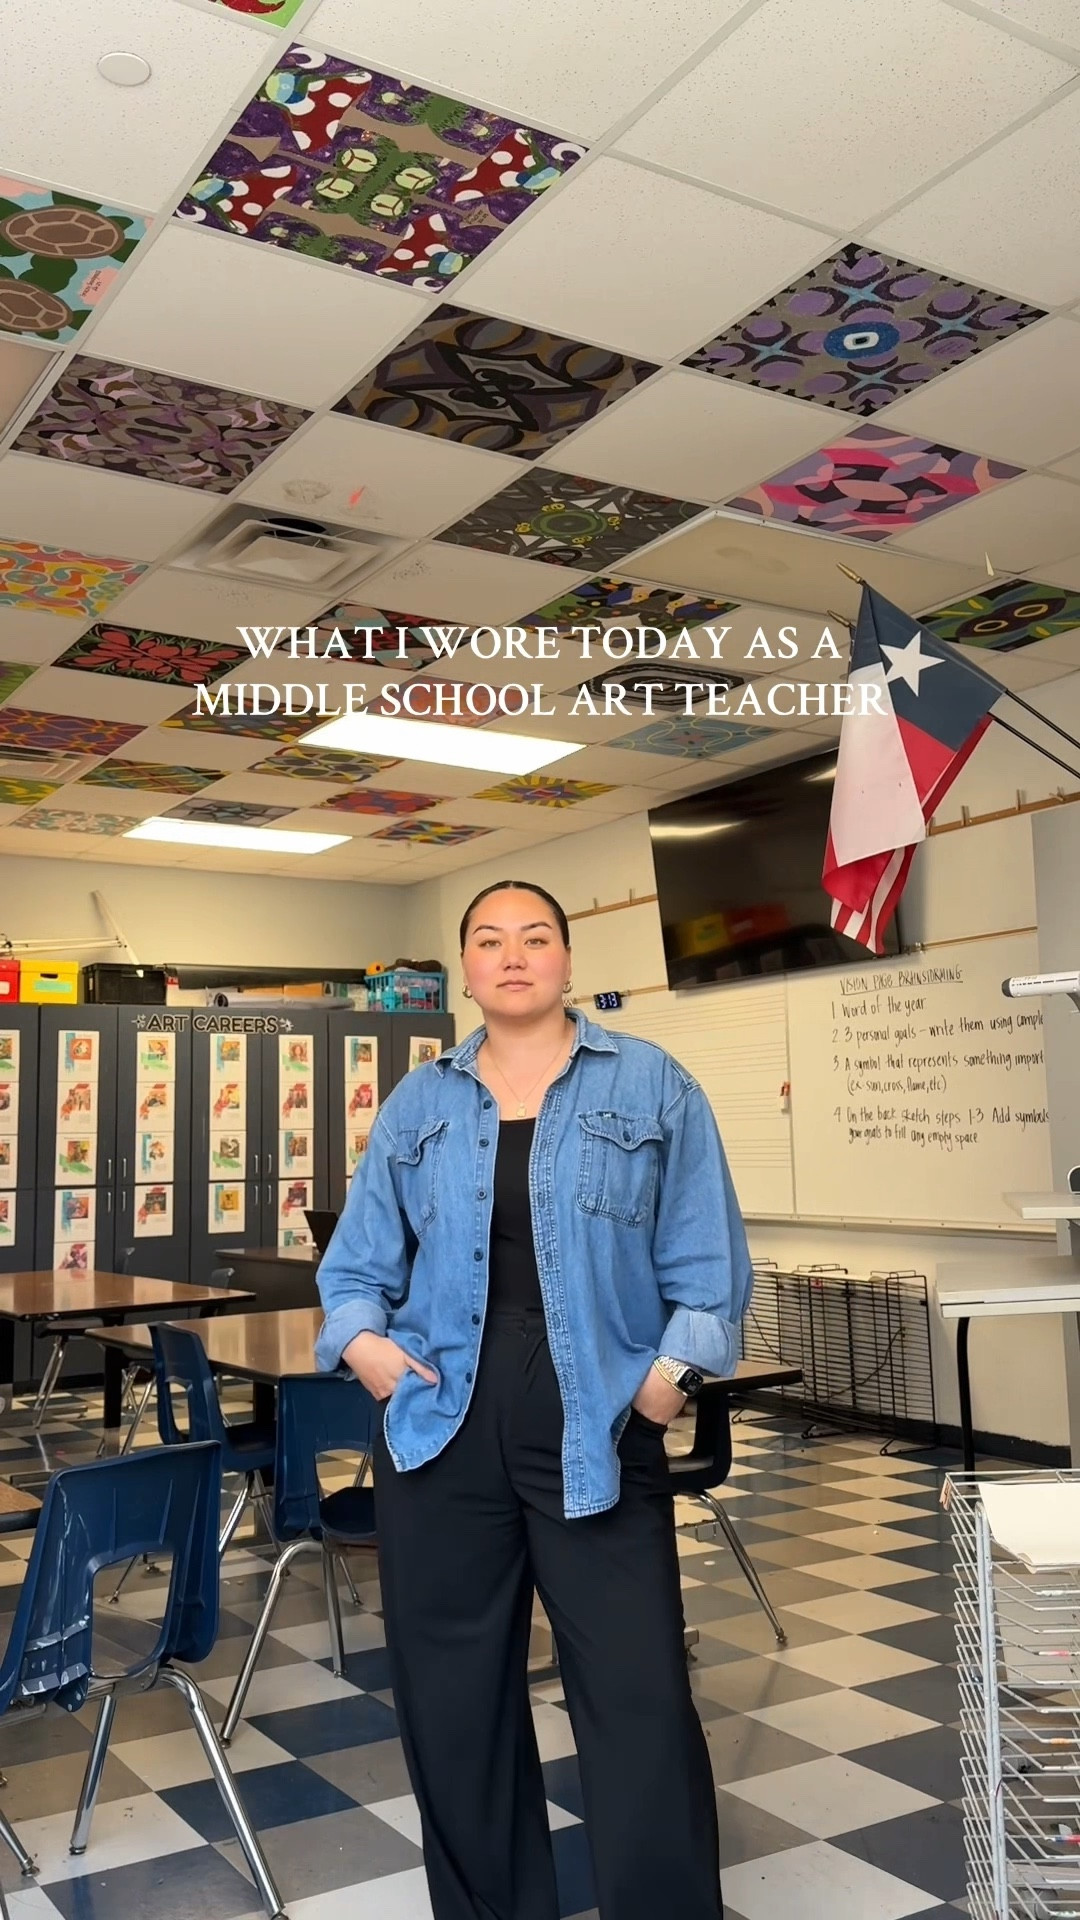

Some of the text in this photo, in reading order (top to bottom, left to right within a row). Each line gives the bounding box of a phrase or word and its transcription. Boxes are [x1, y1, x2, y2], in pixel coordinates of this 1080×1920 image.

[840, 977, 868, 995] VISION
[898, 964, 963, 987] BRAINSTORMING
[871, 994, 882, 1015] of
[887, 996, 902, 1014] the
[904, 998, 927, 1017] year
[147, 1014, 278, 1034] ART CAREERS
[844, 1026, 853, 1042] 3
[856, 1025, 890, 1049] personal
[894, 1023, 917, 1048] goals
[929, 1019, 954, 1037] write
[960, 1017, 984, 1033] them
[990, 1016, 1013, 1035] using
[845, 1057, 851, 1071] A
[854, 1055, 881, 1077] symbol
[886, 1053, 904, 1069] that
[908, 1051, 959, 1073] represents
[963, 1049, 1012, 1072] something
[1015, 1050, 1044, 1071] import
[860, 1106, 874, 1122] the
[877, 1105, 896, 1120] back
[902, 1107, 930, 1124] sketch
[936, 1109, 961, 1128] steps
[992, 1105, 1011, 1123] Add
[864, 1125, 882, 1145] goals
[885, 1125, 893, 1139] to
[895, 1123, 906, 1139] fill
[911, 1130, 925, 1148] any
[928, 1131, 953, 1152] empty
[955, 1132, 978, 1150] space
